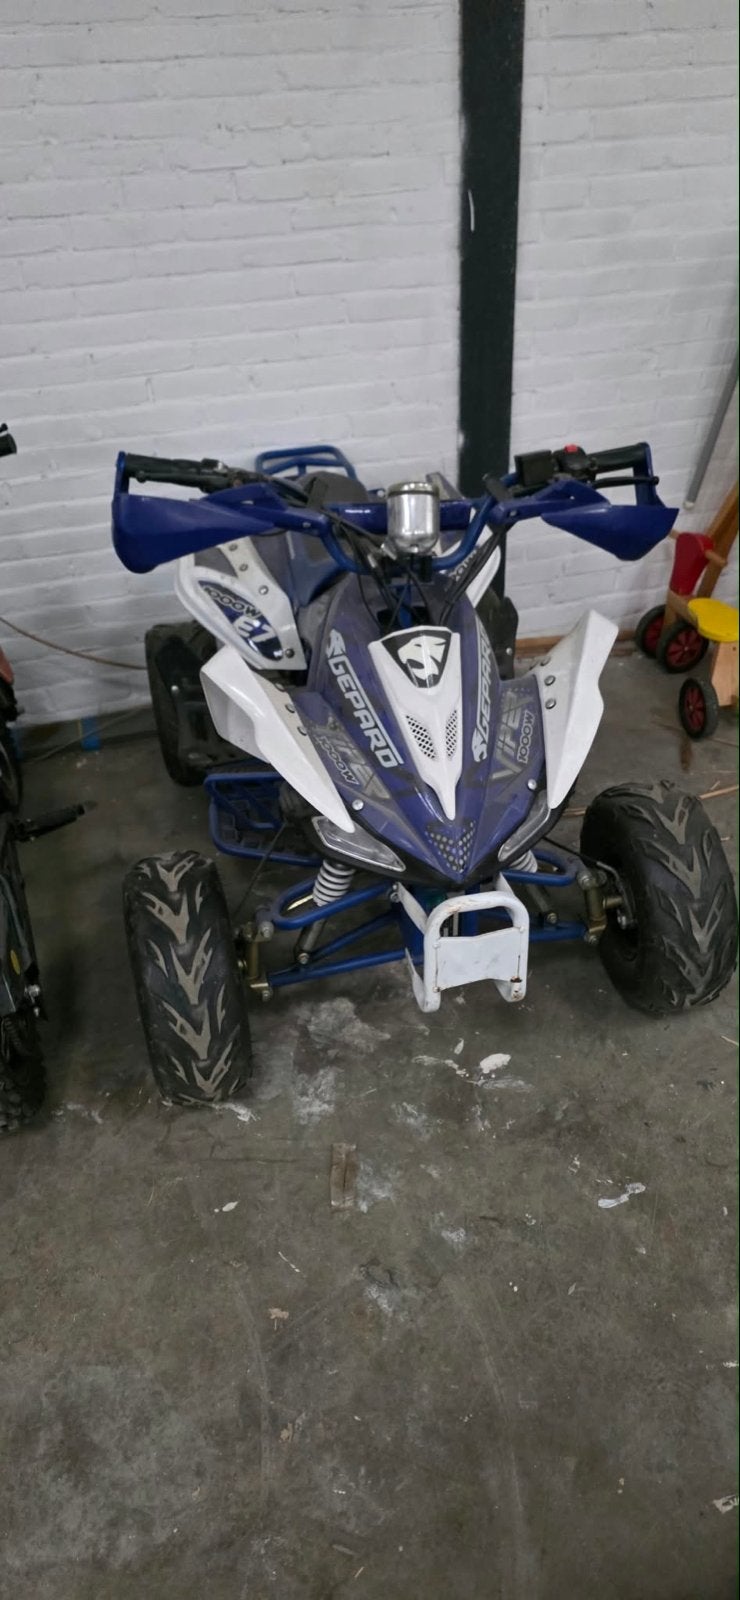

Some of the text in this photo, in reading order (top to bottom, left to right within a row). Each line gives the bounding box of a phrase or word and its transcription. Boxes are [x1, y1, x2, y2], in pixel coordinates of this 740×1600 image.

[203, 587, 261, 618] 1000W
[328, 654, 401, 768] GEPARD
[517, 710, 535, 764] 1000W
